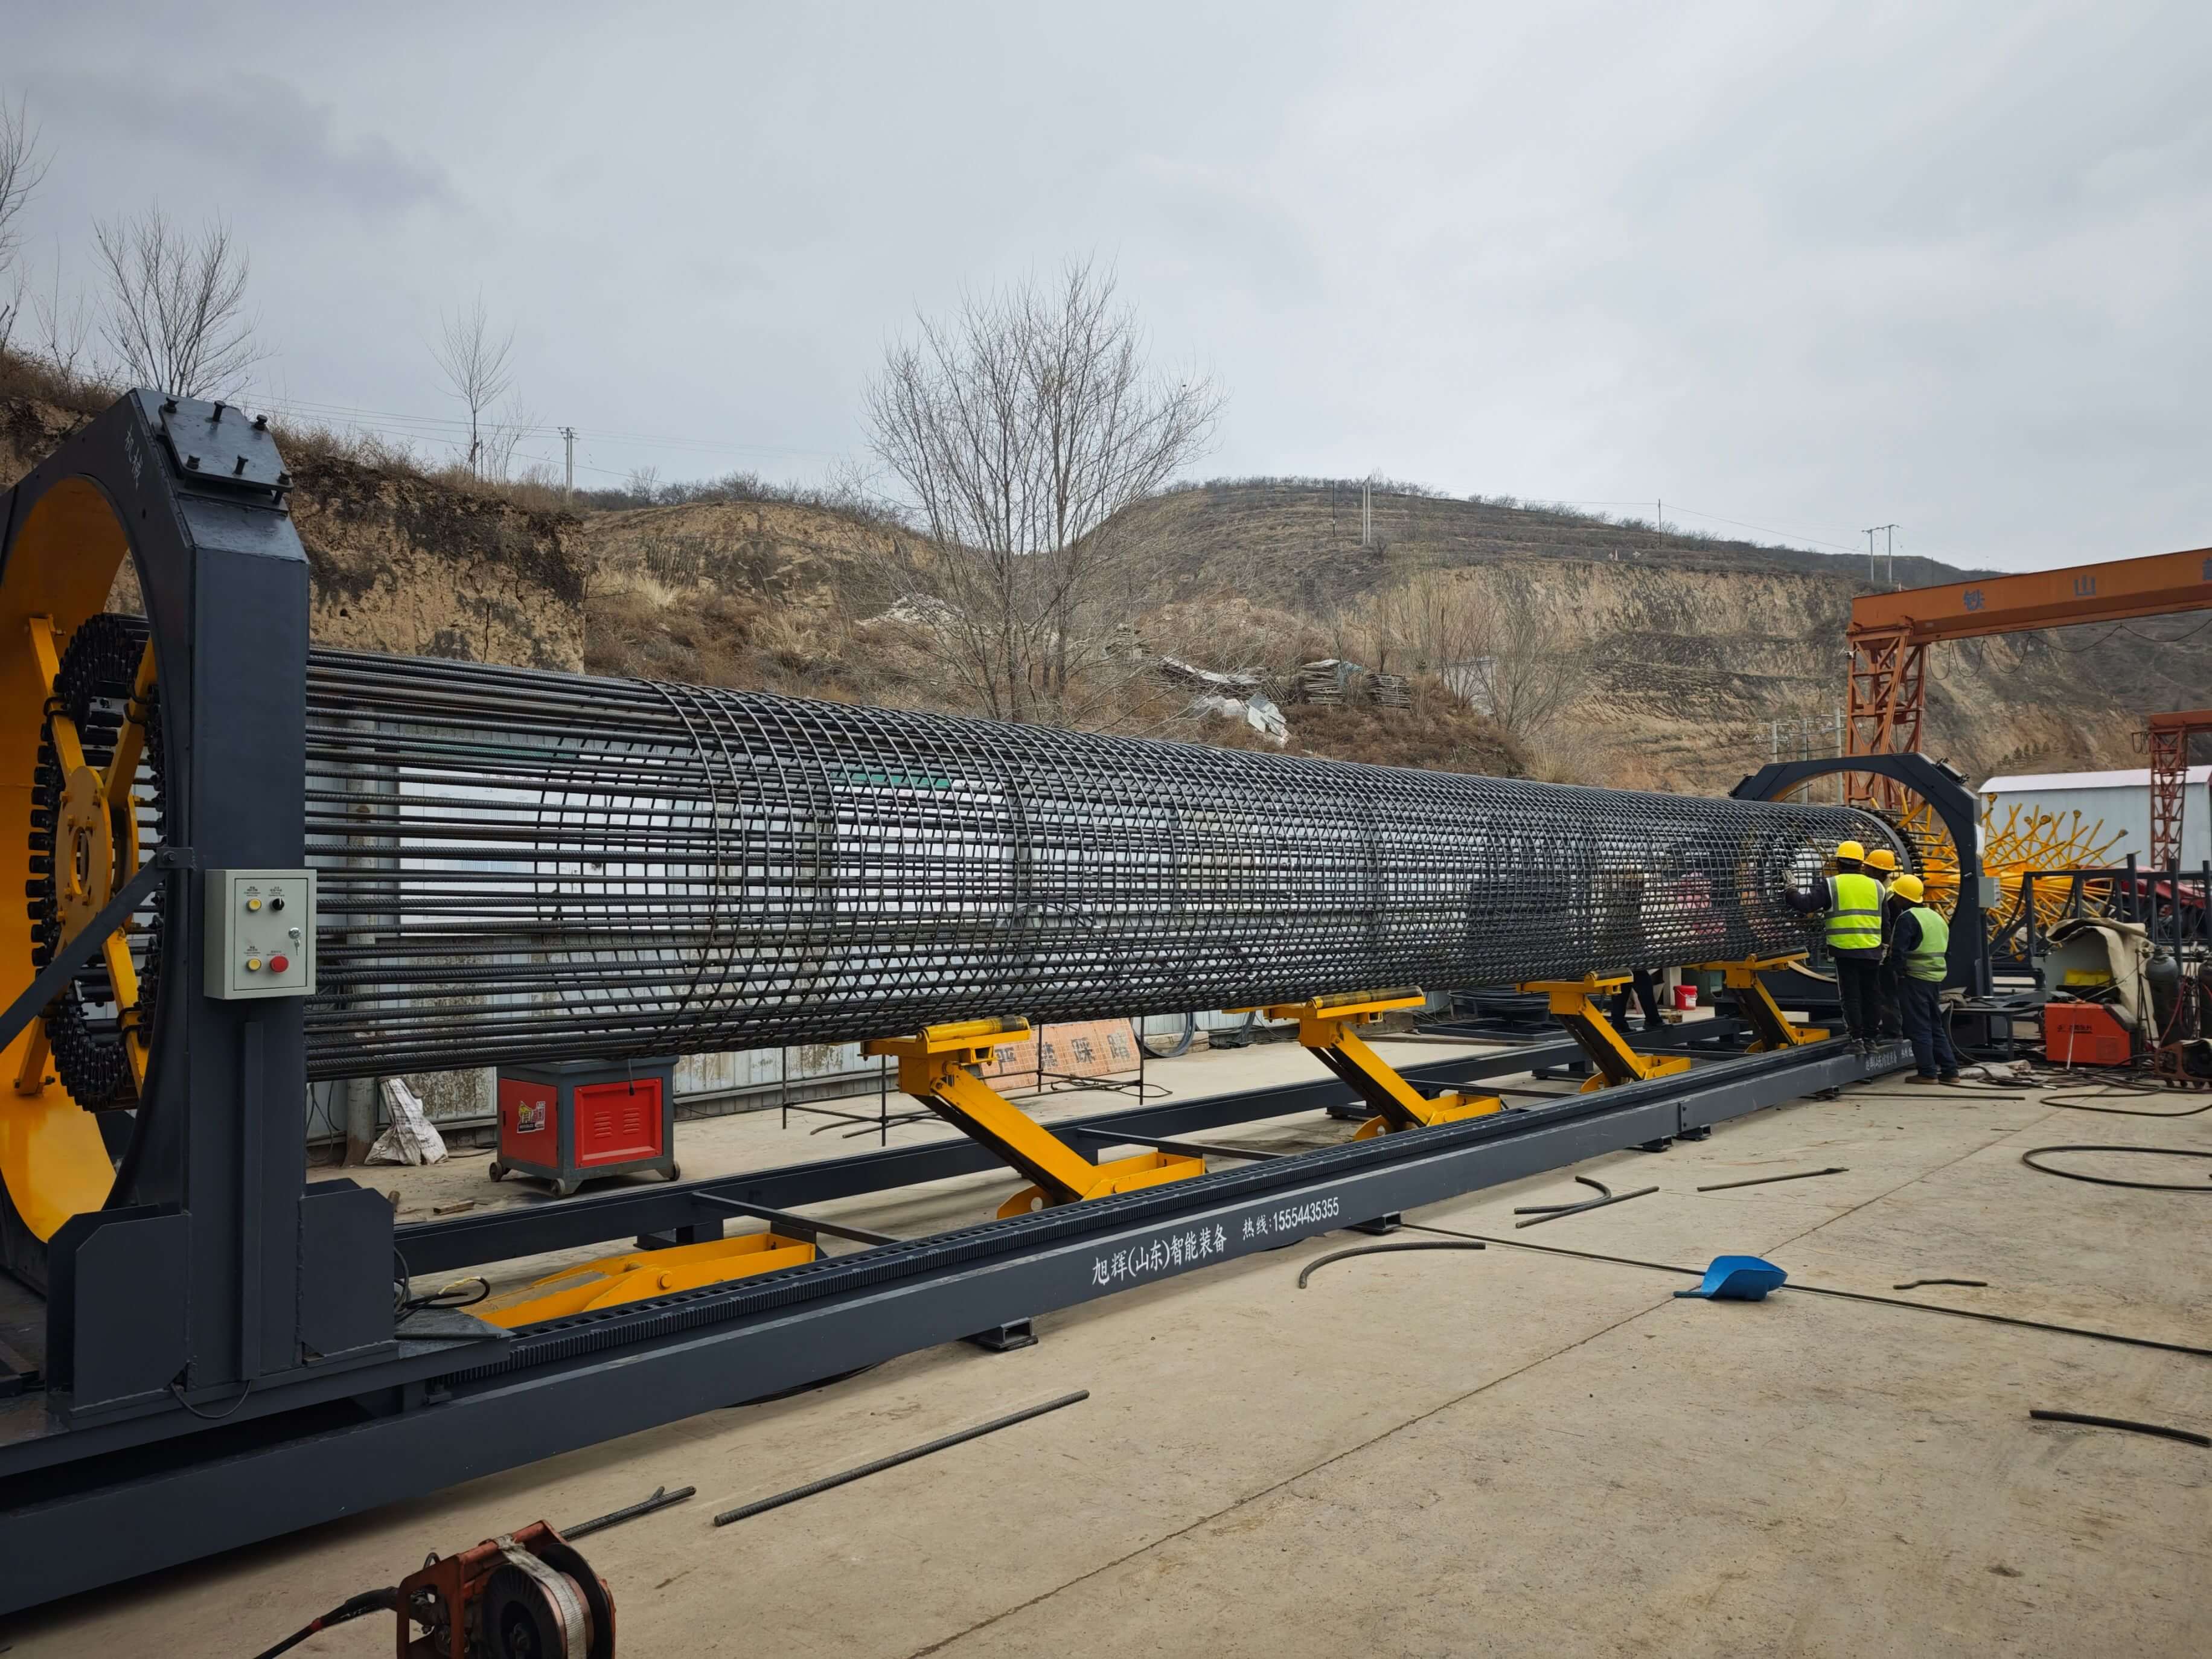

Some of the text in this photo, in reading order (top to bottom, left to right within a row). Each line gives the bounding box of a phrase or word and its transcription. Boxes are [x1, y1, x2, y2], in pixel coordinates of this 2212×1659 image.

[1092, 1223, 1227, 1286] 旭辉(山东)智能装备
